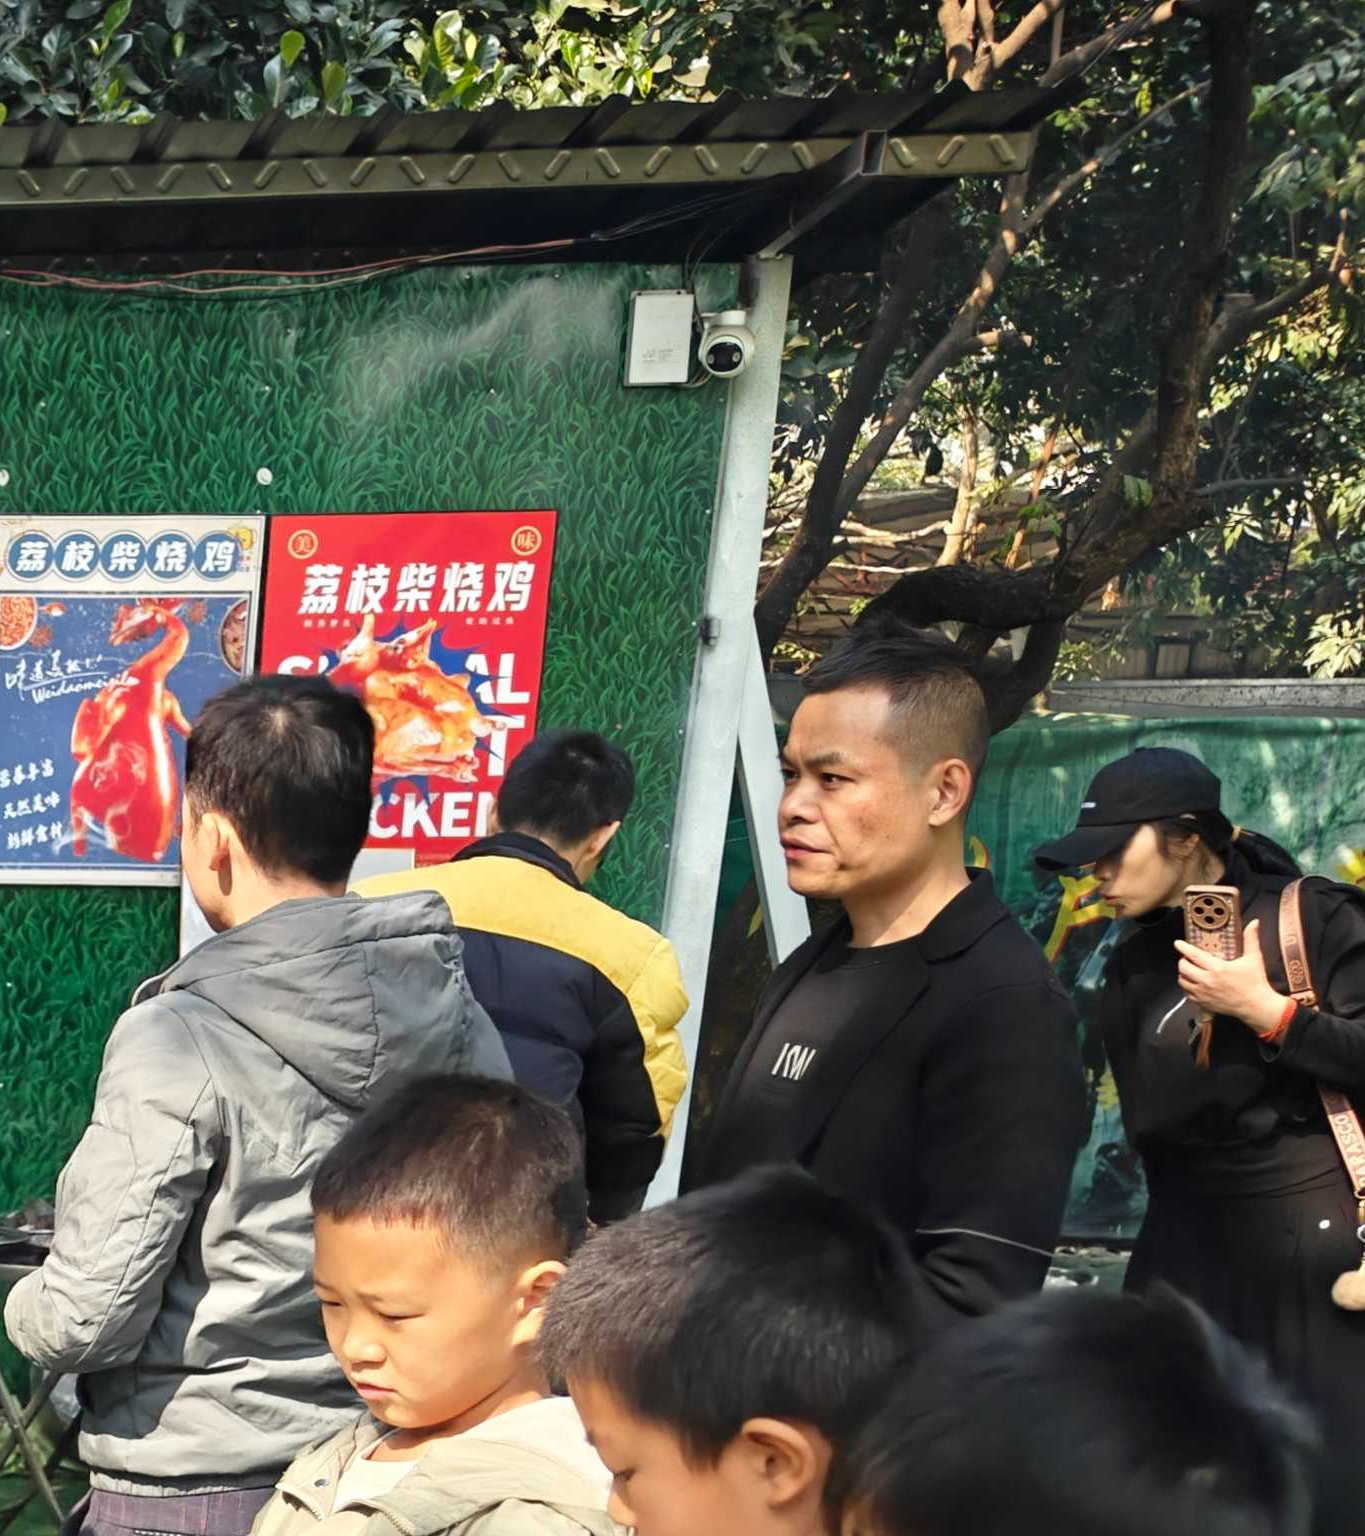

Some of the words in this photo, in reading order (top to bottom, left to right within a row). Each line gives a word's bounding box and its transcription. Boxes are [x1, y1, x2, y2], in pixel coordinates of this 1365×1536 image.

[293, 534, 312, 554] 美
[517, 531, 537, 550] 味
[15, 540, 235, 573] 荔枝柴烧鸡
[297, 560, 535, 615] 荔枝柴烧鸡
